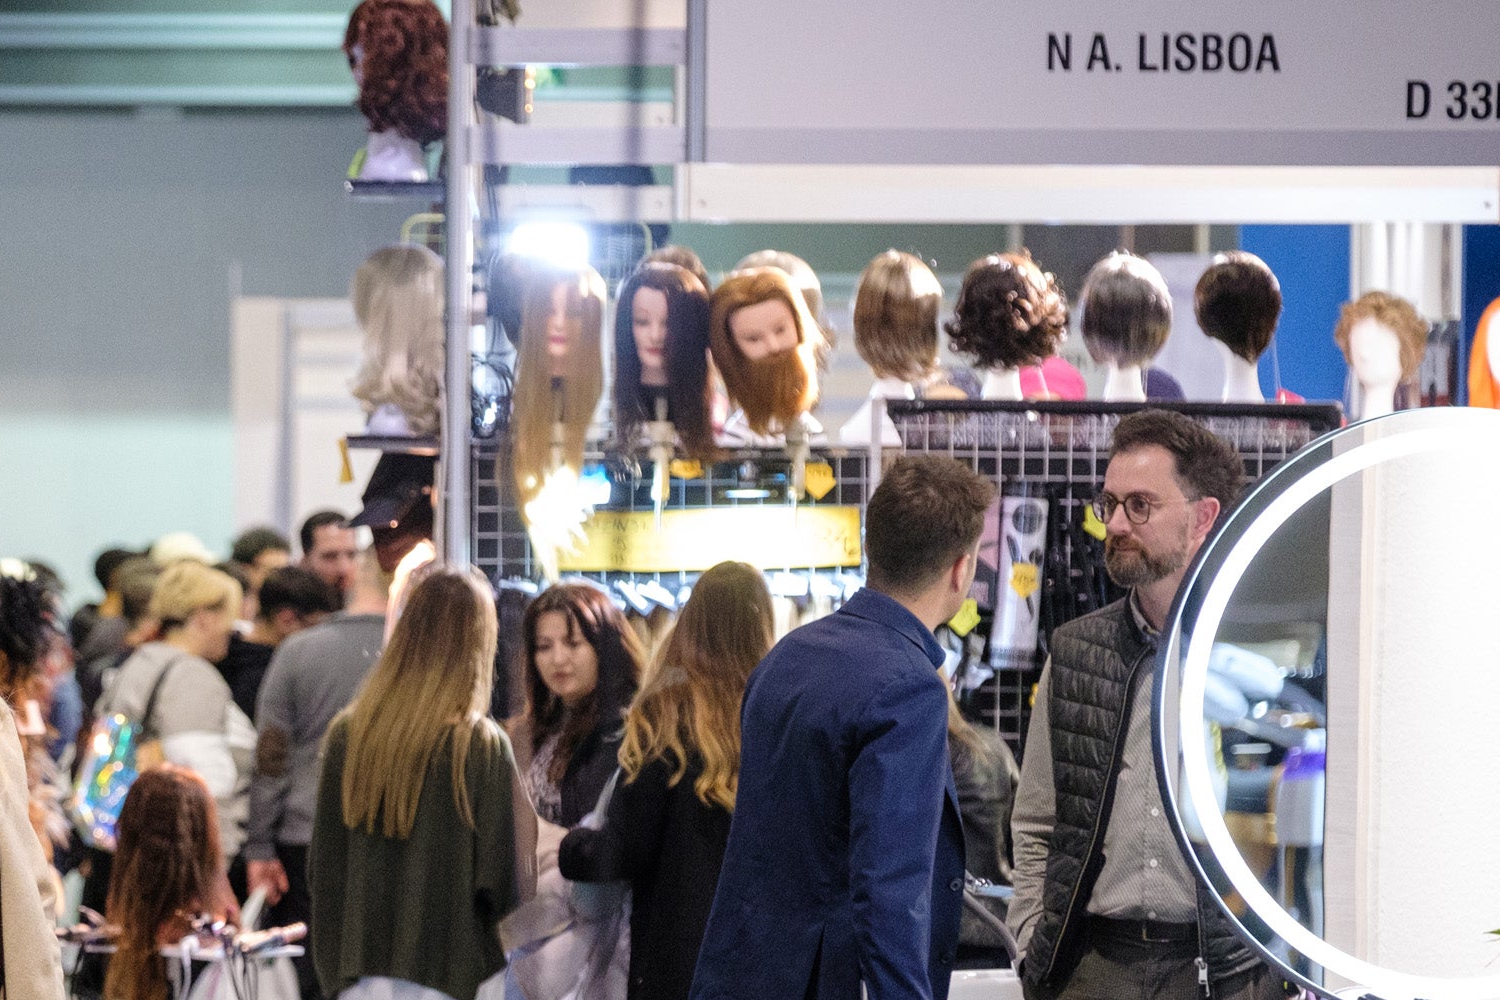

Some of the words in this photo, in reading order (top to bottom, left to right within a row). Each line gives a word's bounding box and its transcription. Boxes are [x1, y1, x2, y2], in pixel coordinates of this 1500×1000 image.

[1047, 33, 1072, 71] N
[1086, 33, 1122, 71] A.
[1138, 32, 1281, 72] LISBOA
[1405, 80, 1432, 119] D
[1445, 80, 1500, 120] 33
